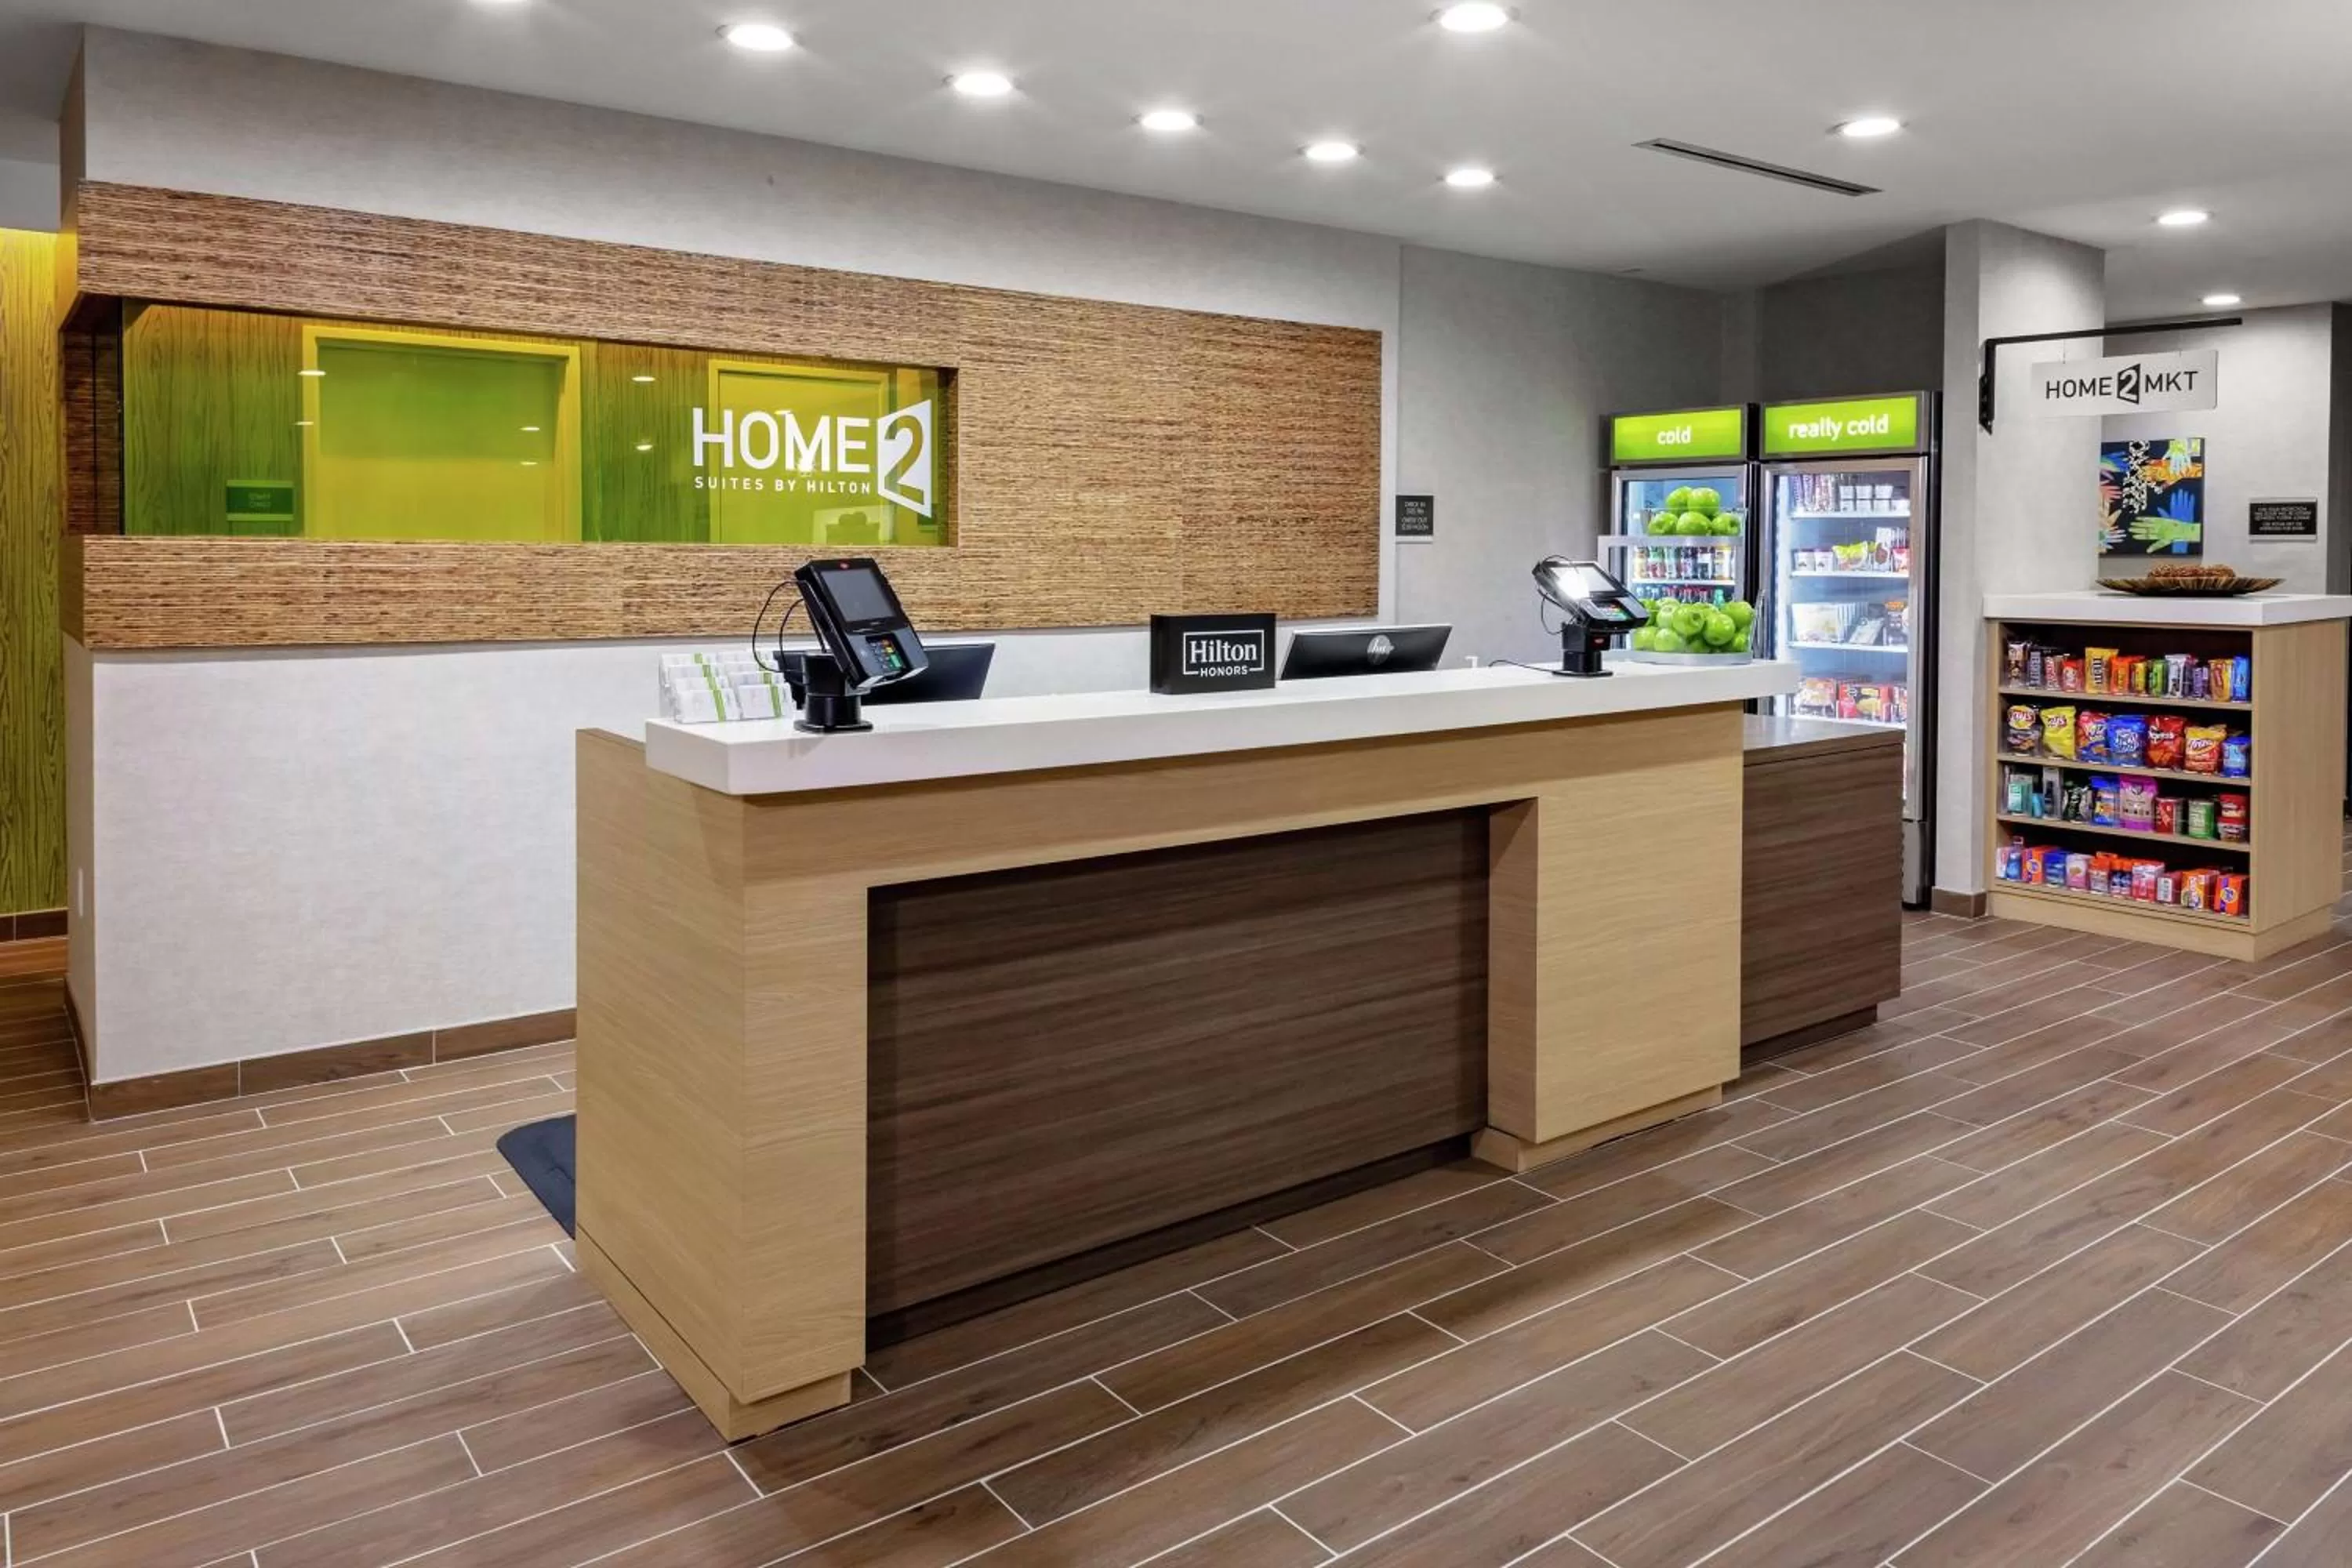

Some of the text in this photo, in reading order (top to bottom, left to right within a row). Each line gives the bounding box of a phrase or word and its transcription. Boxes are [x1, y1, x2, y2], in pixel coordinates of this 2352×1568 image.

[2045, 376, 2113, 399] HOME
[2143, 371, 2199, 393] MKT
[1657, 425, 1692, 445] cold
[1788, 414, 1889, 441] really cold
[692, 407, 870, 474] HOME
[694, 476, 871, 495] SUITES BY HILTON
[1189, 639, 1258, 664] Hilton
[1200, 665, 1249, 677] HONORS
